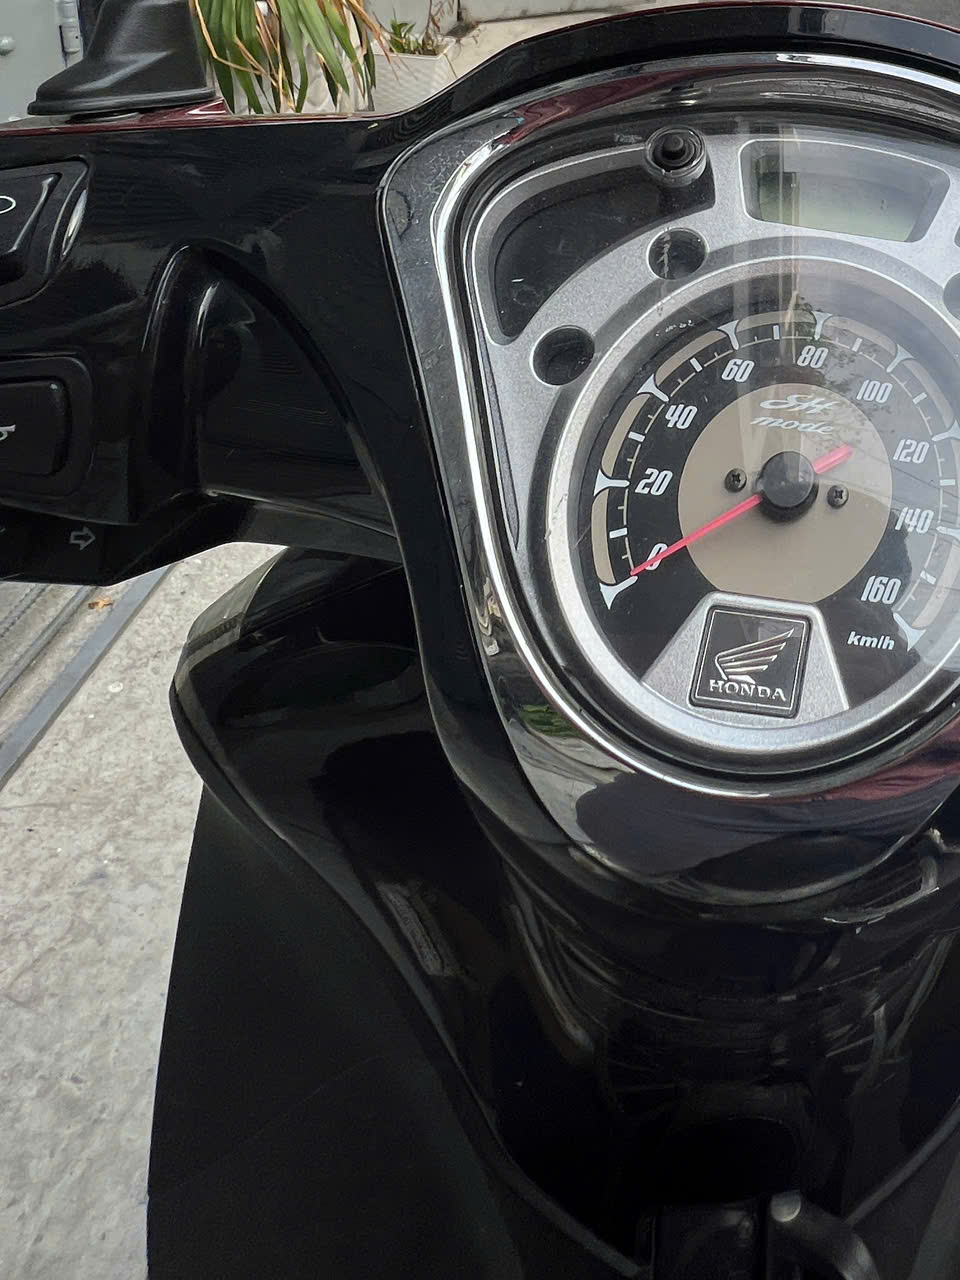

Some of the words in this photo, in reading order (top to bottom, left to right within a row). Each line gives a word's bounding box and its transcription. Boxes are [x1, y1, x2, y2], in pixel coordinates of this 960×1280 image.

[797, 346, 825, 369] 80
[721, 358, 754, 383] 60
[856, 380, 893, 404] 100
[665, 404, 698, 430] 40
[750, 416, 834, 435] mode
[893, 439, 930, 464] 120
[635, 468, 673, 496] 20
[895, 507, 934, 534] 140
[860, 575, 902, 605] 160
[847, 631, 895, 651] km/h
[709, 678, 787, 703] HONDA
